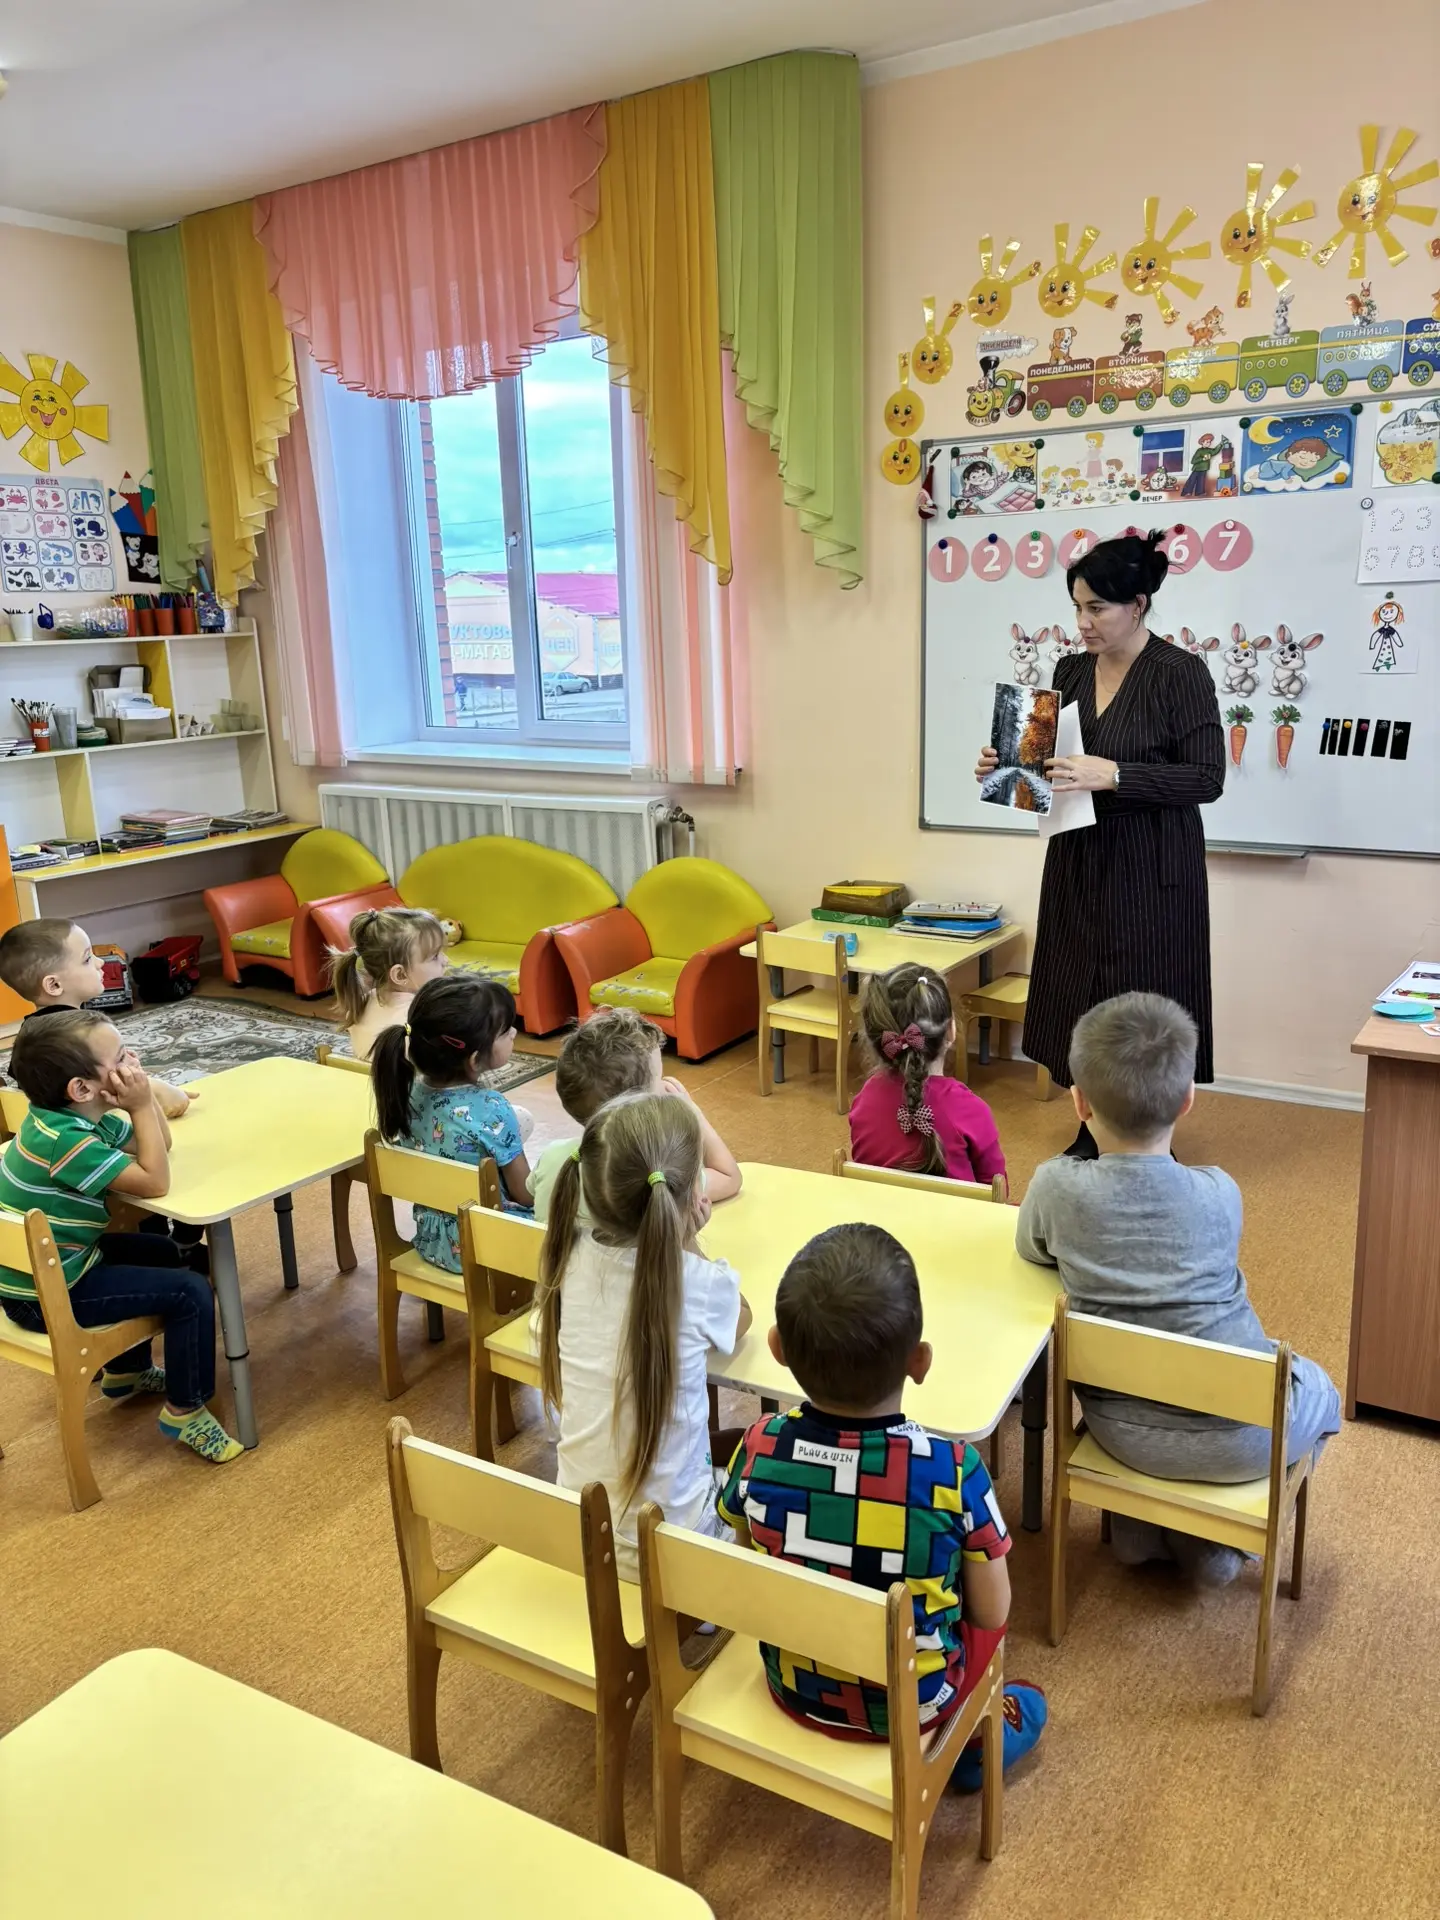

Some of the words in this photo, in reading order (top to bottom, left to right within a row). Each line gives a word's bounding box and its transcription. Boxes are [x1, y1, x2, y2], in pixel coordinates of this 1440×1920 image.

[1237, 290, 1249, 308] 6
[948, 303, 962, 318] 2
[1336, 326, 1390, 339] ПЯТНИЦА
[1257, 336, 1300, 348] ЧЕТВЕРГ
[1030, 361, 1091, 376] ПОНЕДЕЛЬНИК
[1108, 355, 1149, 367] ВТОРНИК
[35, 478, 59, 486] ЦВЕТА
[1390, 507, 1405, 532] 2
[1416, 506, 1432, 531] 3
[1168, 534, 1190, 564] 6
[1218, 530, 1240, 561] 7
[943, 546, 953, 573] 1
[983, 545, 1001, 573] 2
[1026, 540, 1044, 569] 3
[1069, 537, 1089, 559] 4
[1364, 546, 1379, 571] 6
[1387, 545, 1400, 568] 7
[1406, 545, 1424, 568] 8
[830, 1452, 854, 1463] WIN
